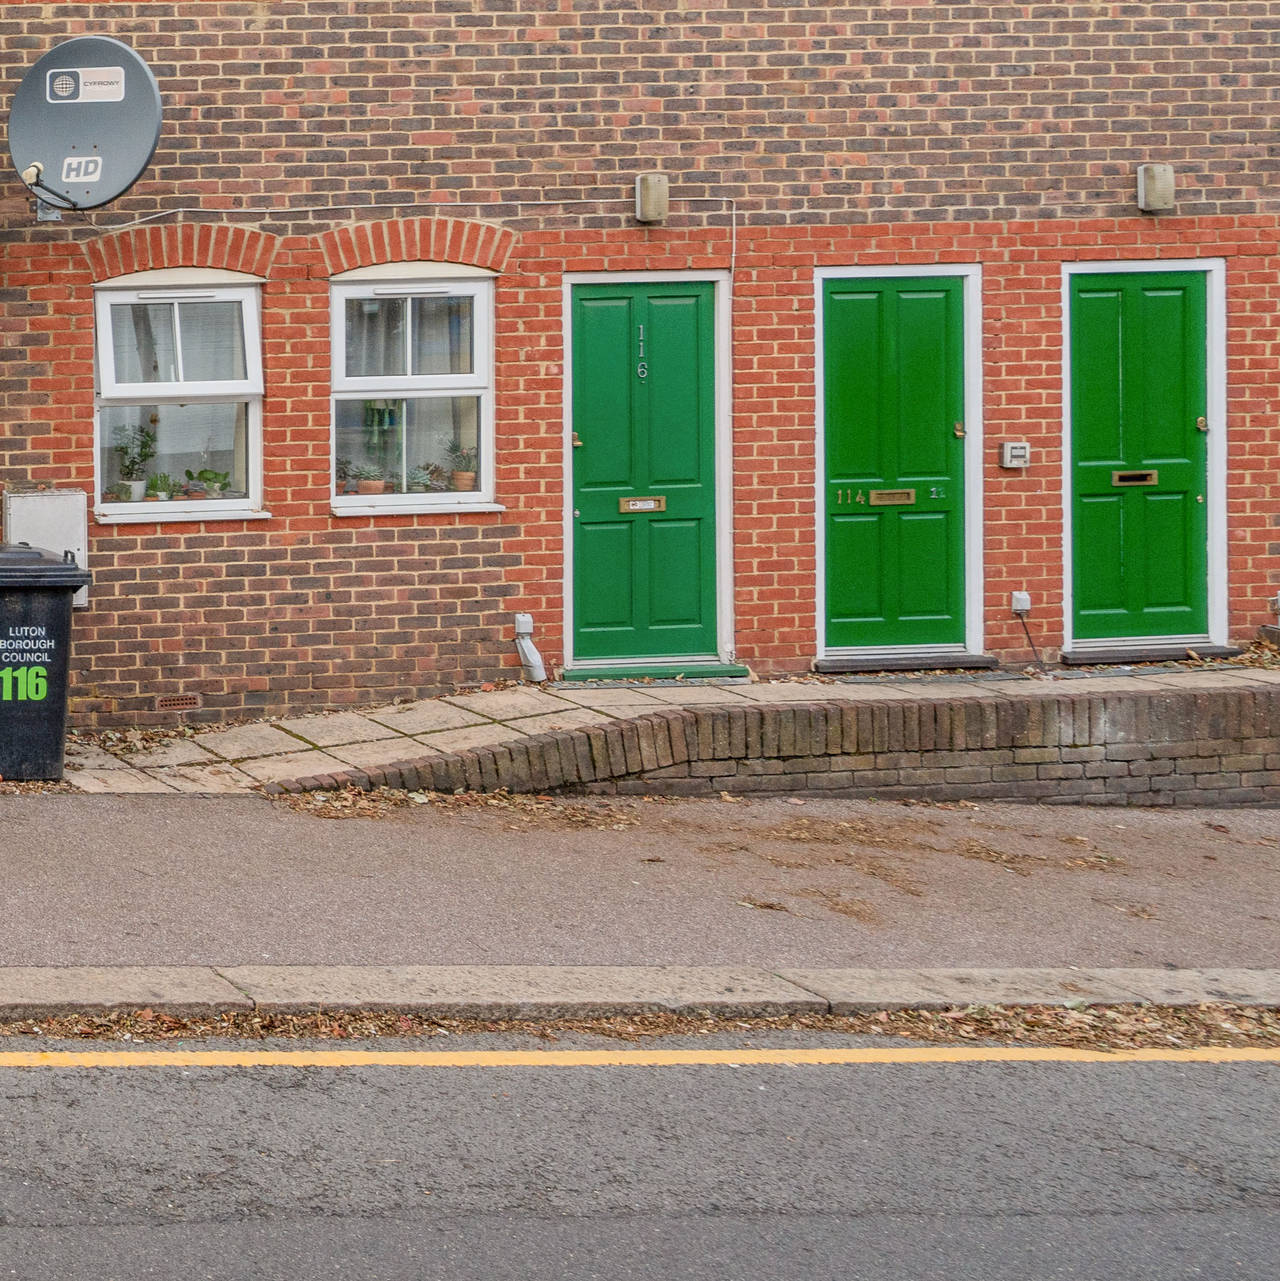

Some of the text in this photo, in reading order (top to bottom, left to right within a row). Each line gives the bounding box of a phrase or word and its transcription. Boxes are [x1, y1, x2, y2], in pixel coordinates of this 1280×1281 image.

[65, 159, 99, 179] HD
[637, 324, 648, 378] 116
[837, 489, 865, 504] 114
[9, 626, 46, 636] LUTON
[0, 639, 55, 649] BOROUGH
[2, 652, 52, 662] COUNCIL
